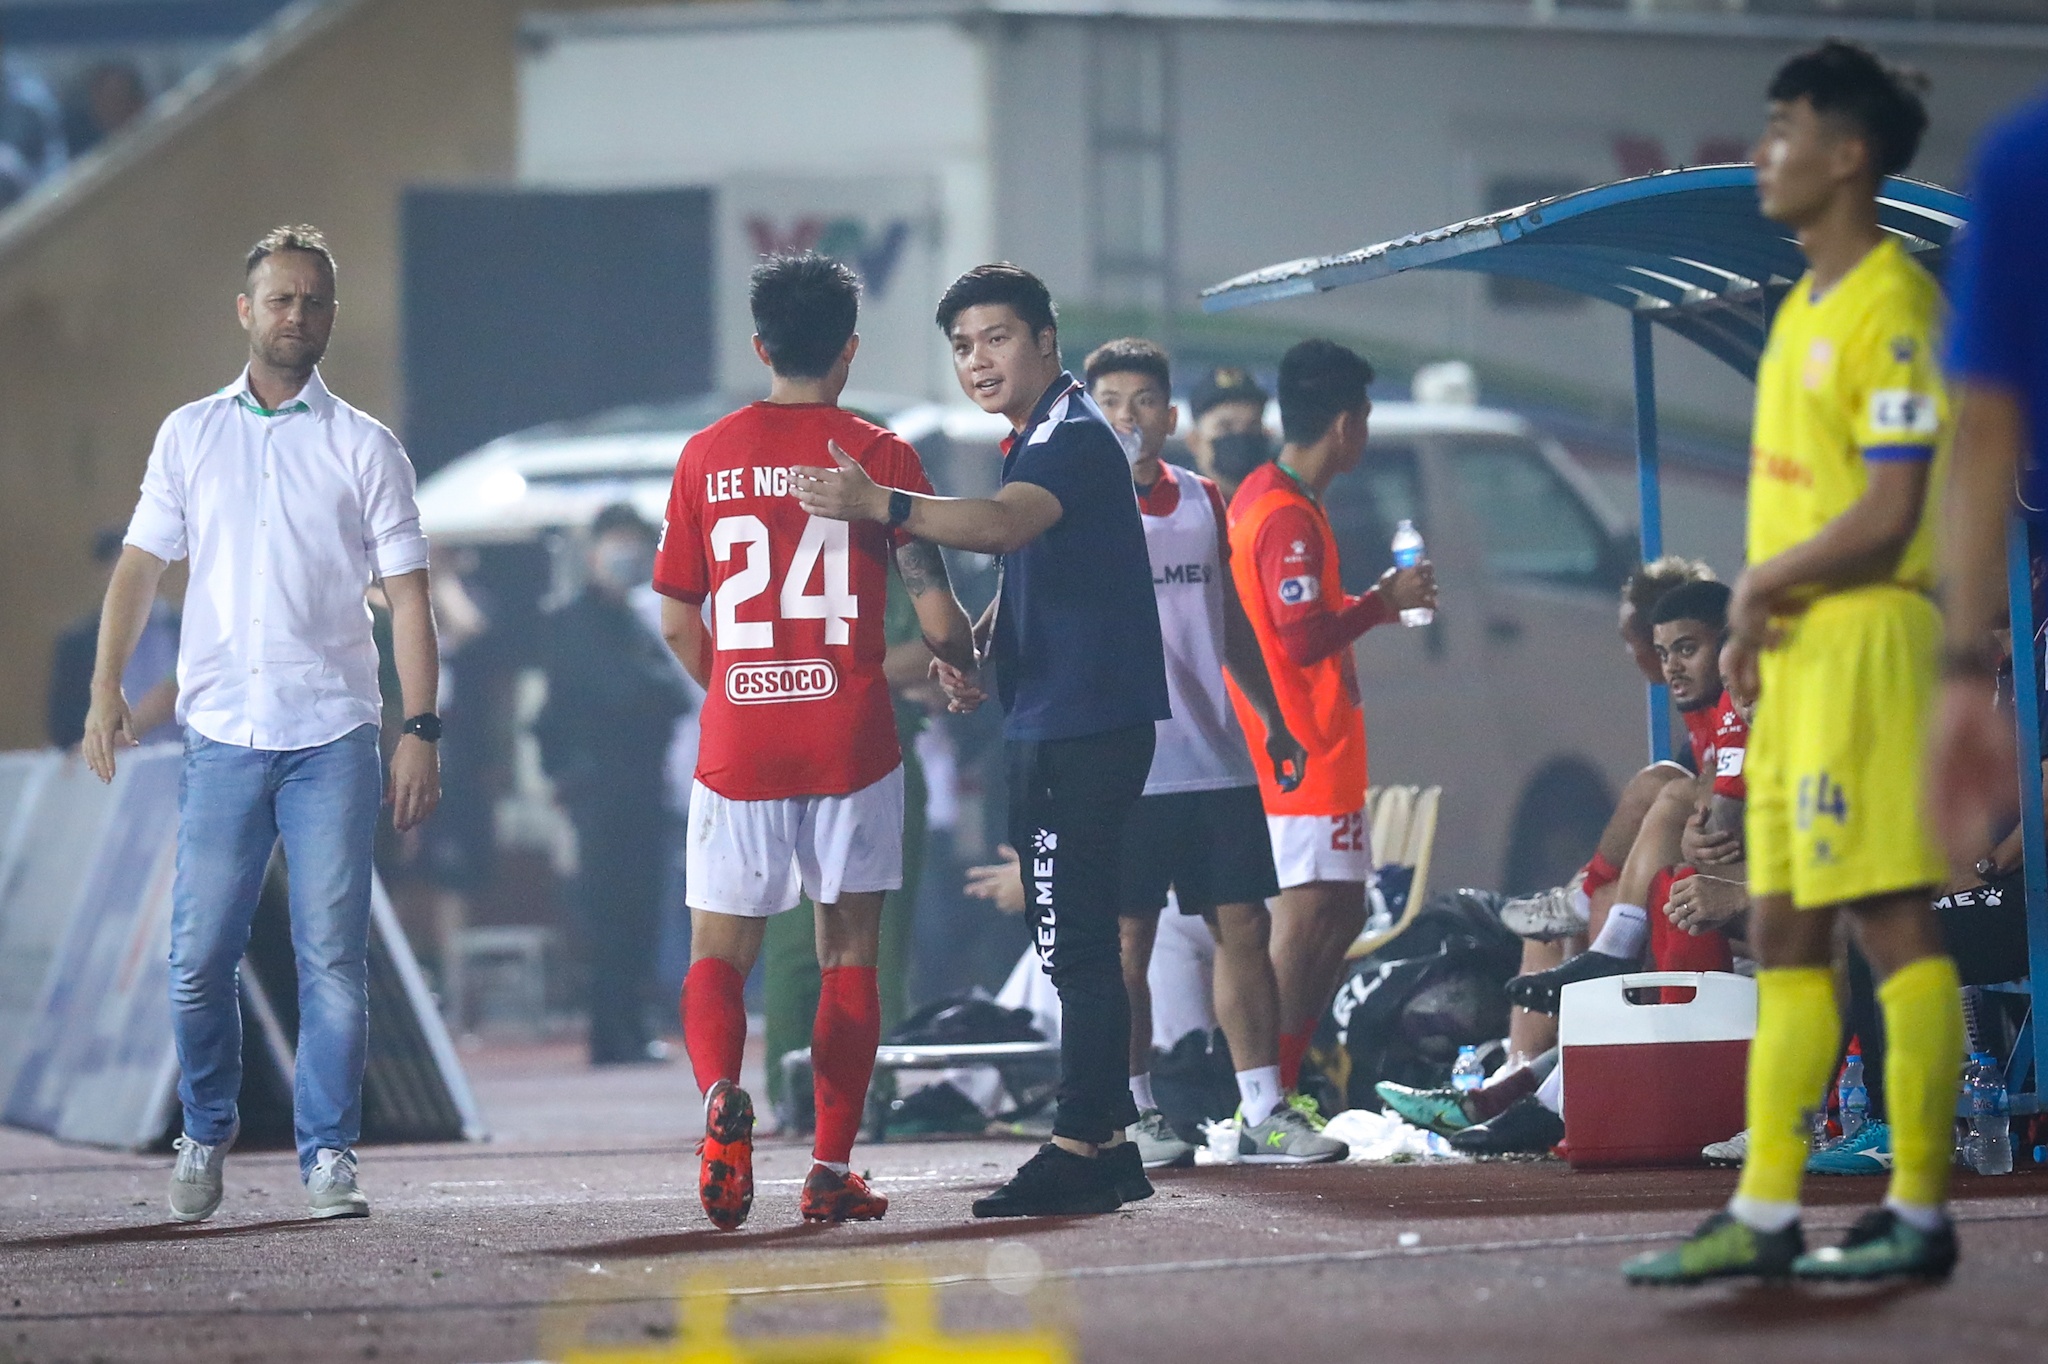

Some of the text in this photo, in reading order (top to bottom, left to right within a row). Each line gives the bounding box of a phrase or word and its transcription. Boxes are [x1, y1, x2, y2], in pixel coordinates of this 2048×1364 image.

[705, 467, 745, 504] LEE
[709, 514, 858, 651] 24
[735, 667, 827, 695] essoco
[1033, 857, 1058, 968] KELME
